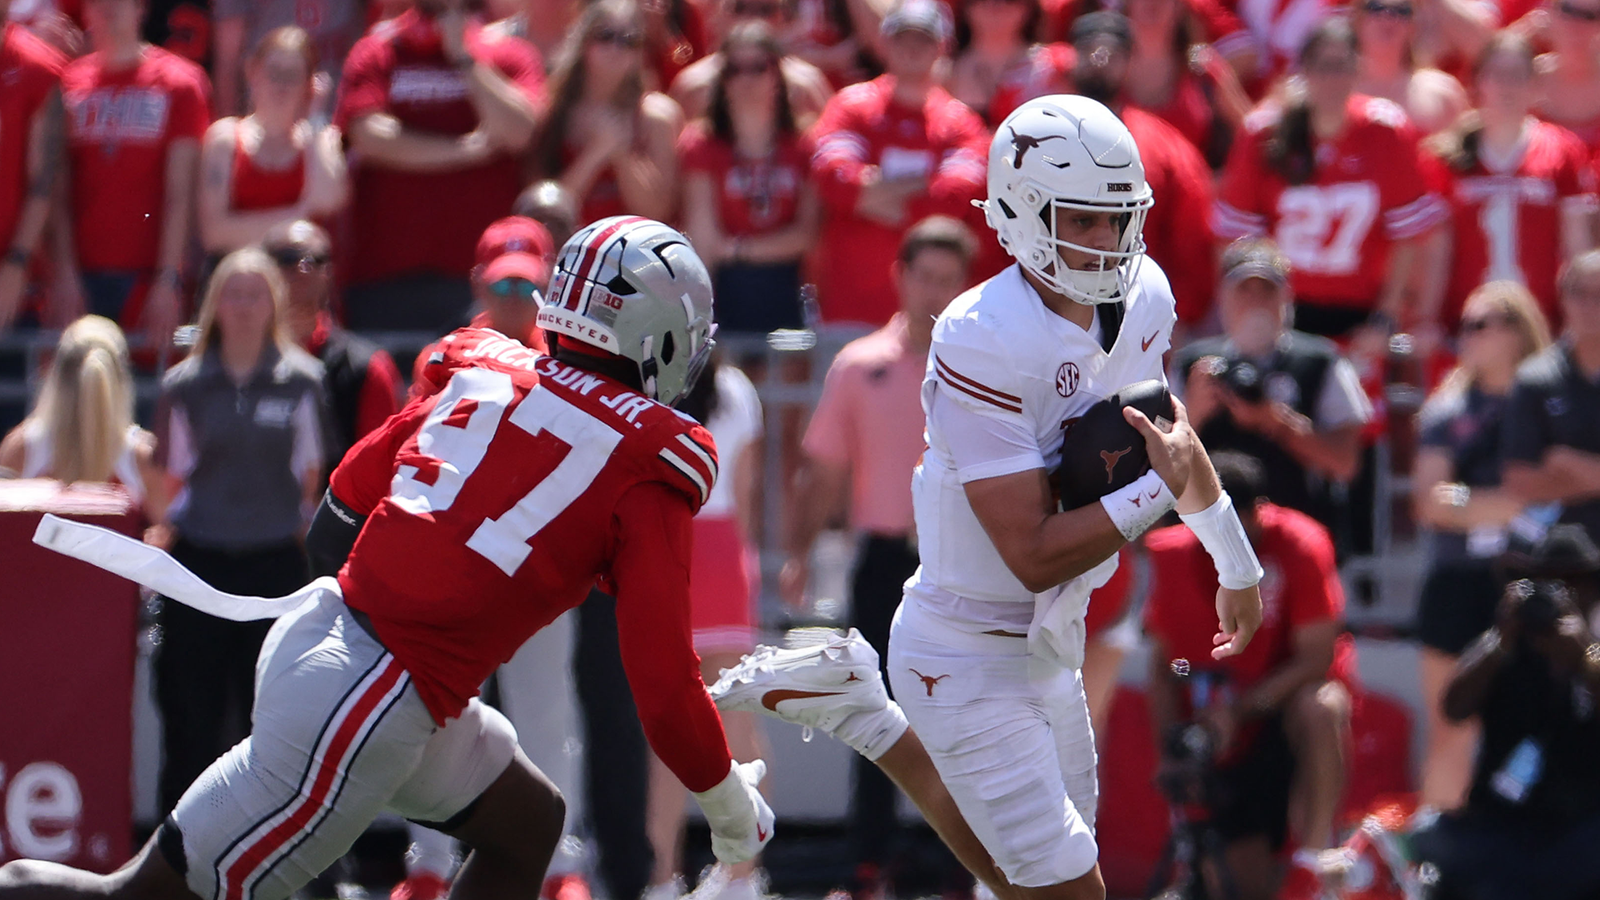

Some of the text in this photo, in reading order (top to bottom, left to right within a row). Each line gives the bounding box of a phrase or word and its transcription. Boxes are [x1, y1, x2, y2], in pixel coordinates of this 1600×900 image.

[1276, 182, 1380, 274] 27
[538, 313, 609, 344] BUCKEYES
[1057, 363, 1079, 396] SEC
[390, 366, 625, 578] 97
